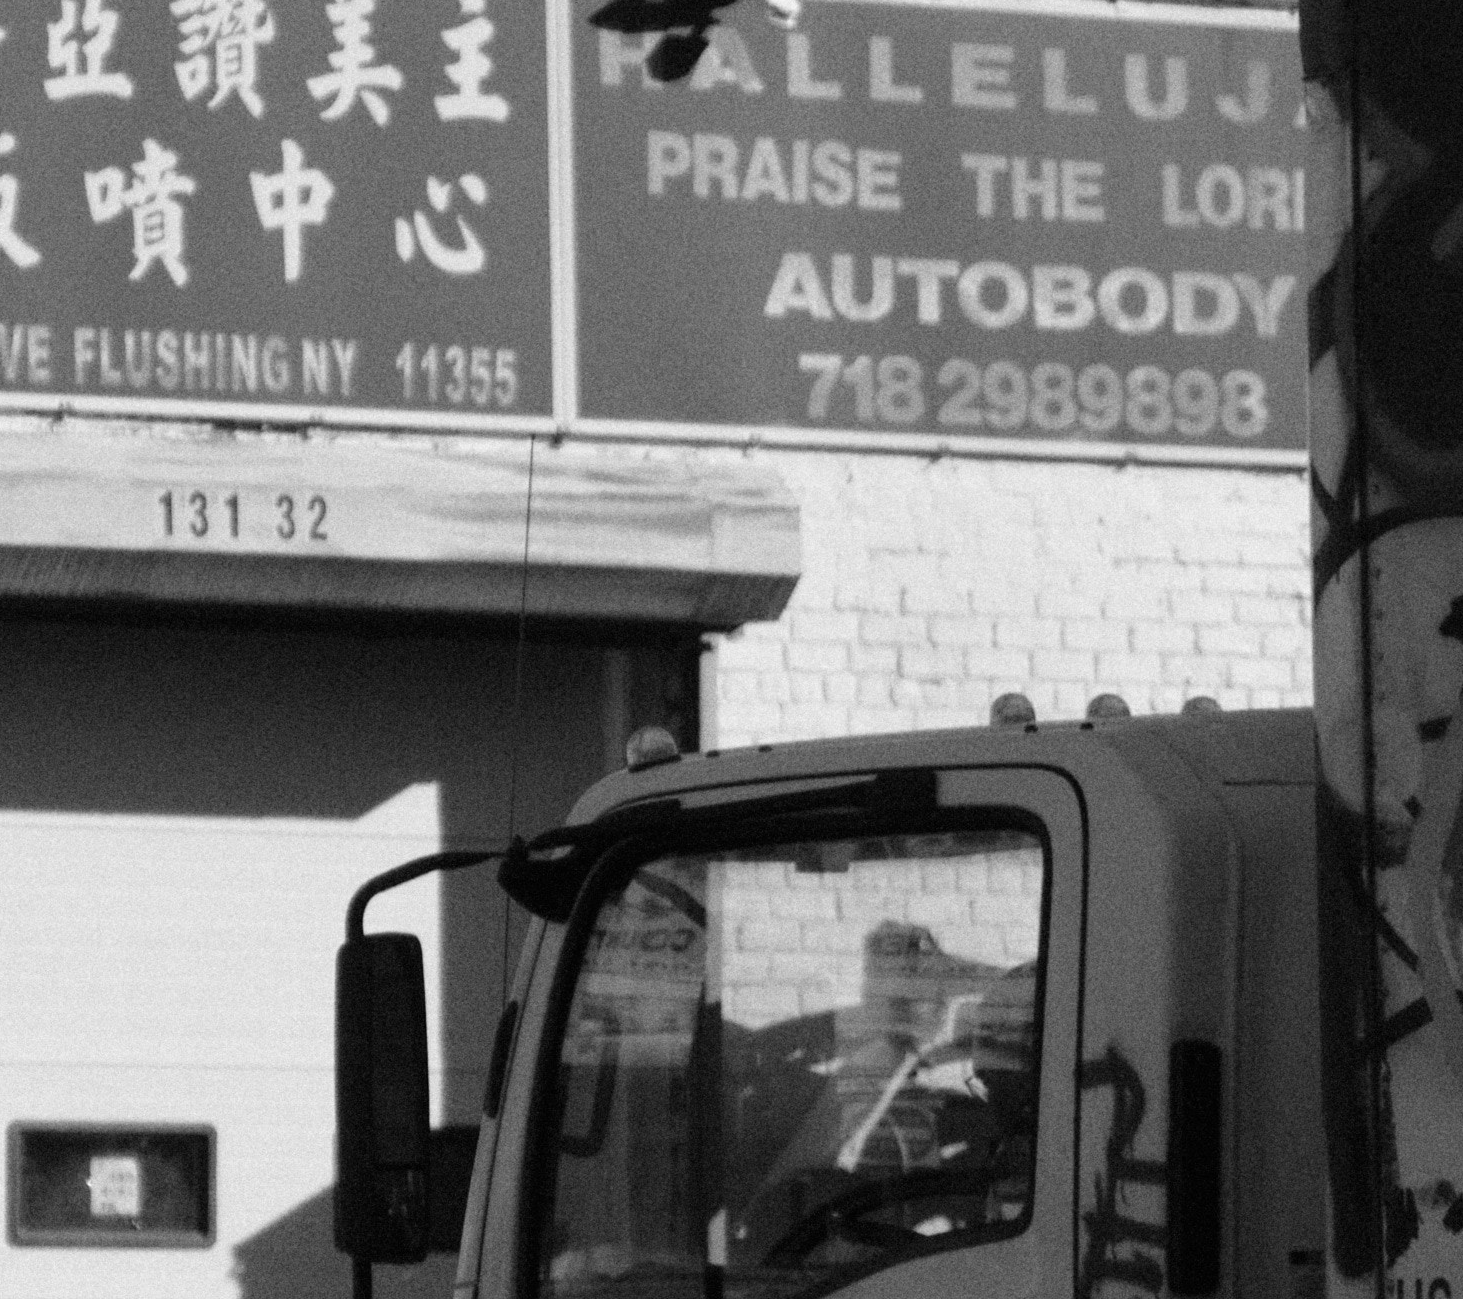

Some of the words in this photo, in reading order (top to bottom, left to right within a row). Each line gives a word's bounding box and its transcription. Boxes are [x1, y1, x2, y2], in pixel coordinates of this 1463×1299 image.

[646, 128, 903, 212] PRAISE
[961, 151, 1106, 223] THE
[763, 251, 1297, 337] AUTOBODY
[395, 342, 518, 405] 11355
[798, 352, 926, 426] 718
[936, 357, 1270, 438] 2989898
[276, 493, 329, 541] 32
